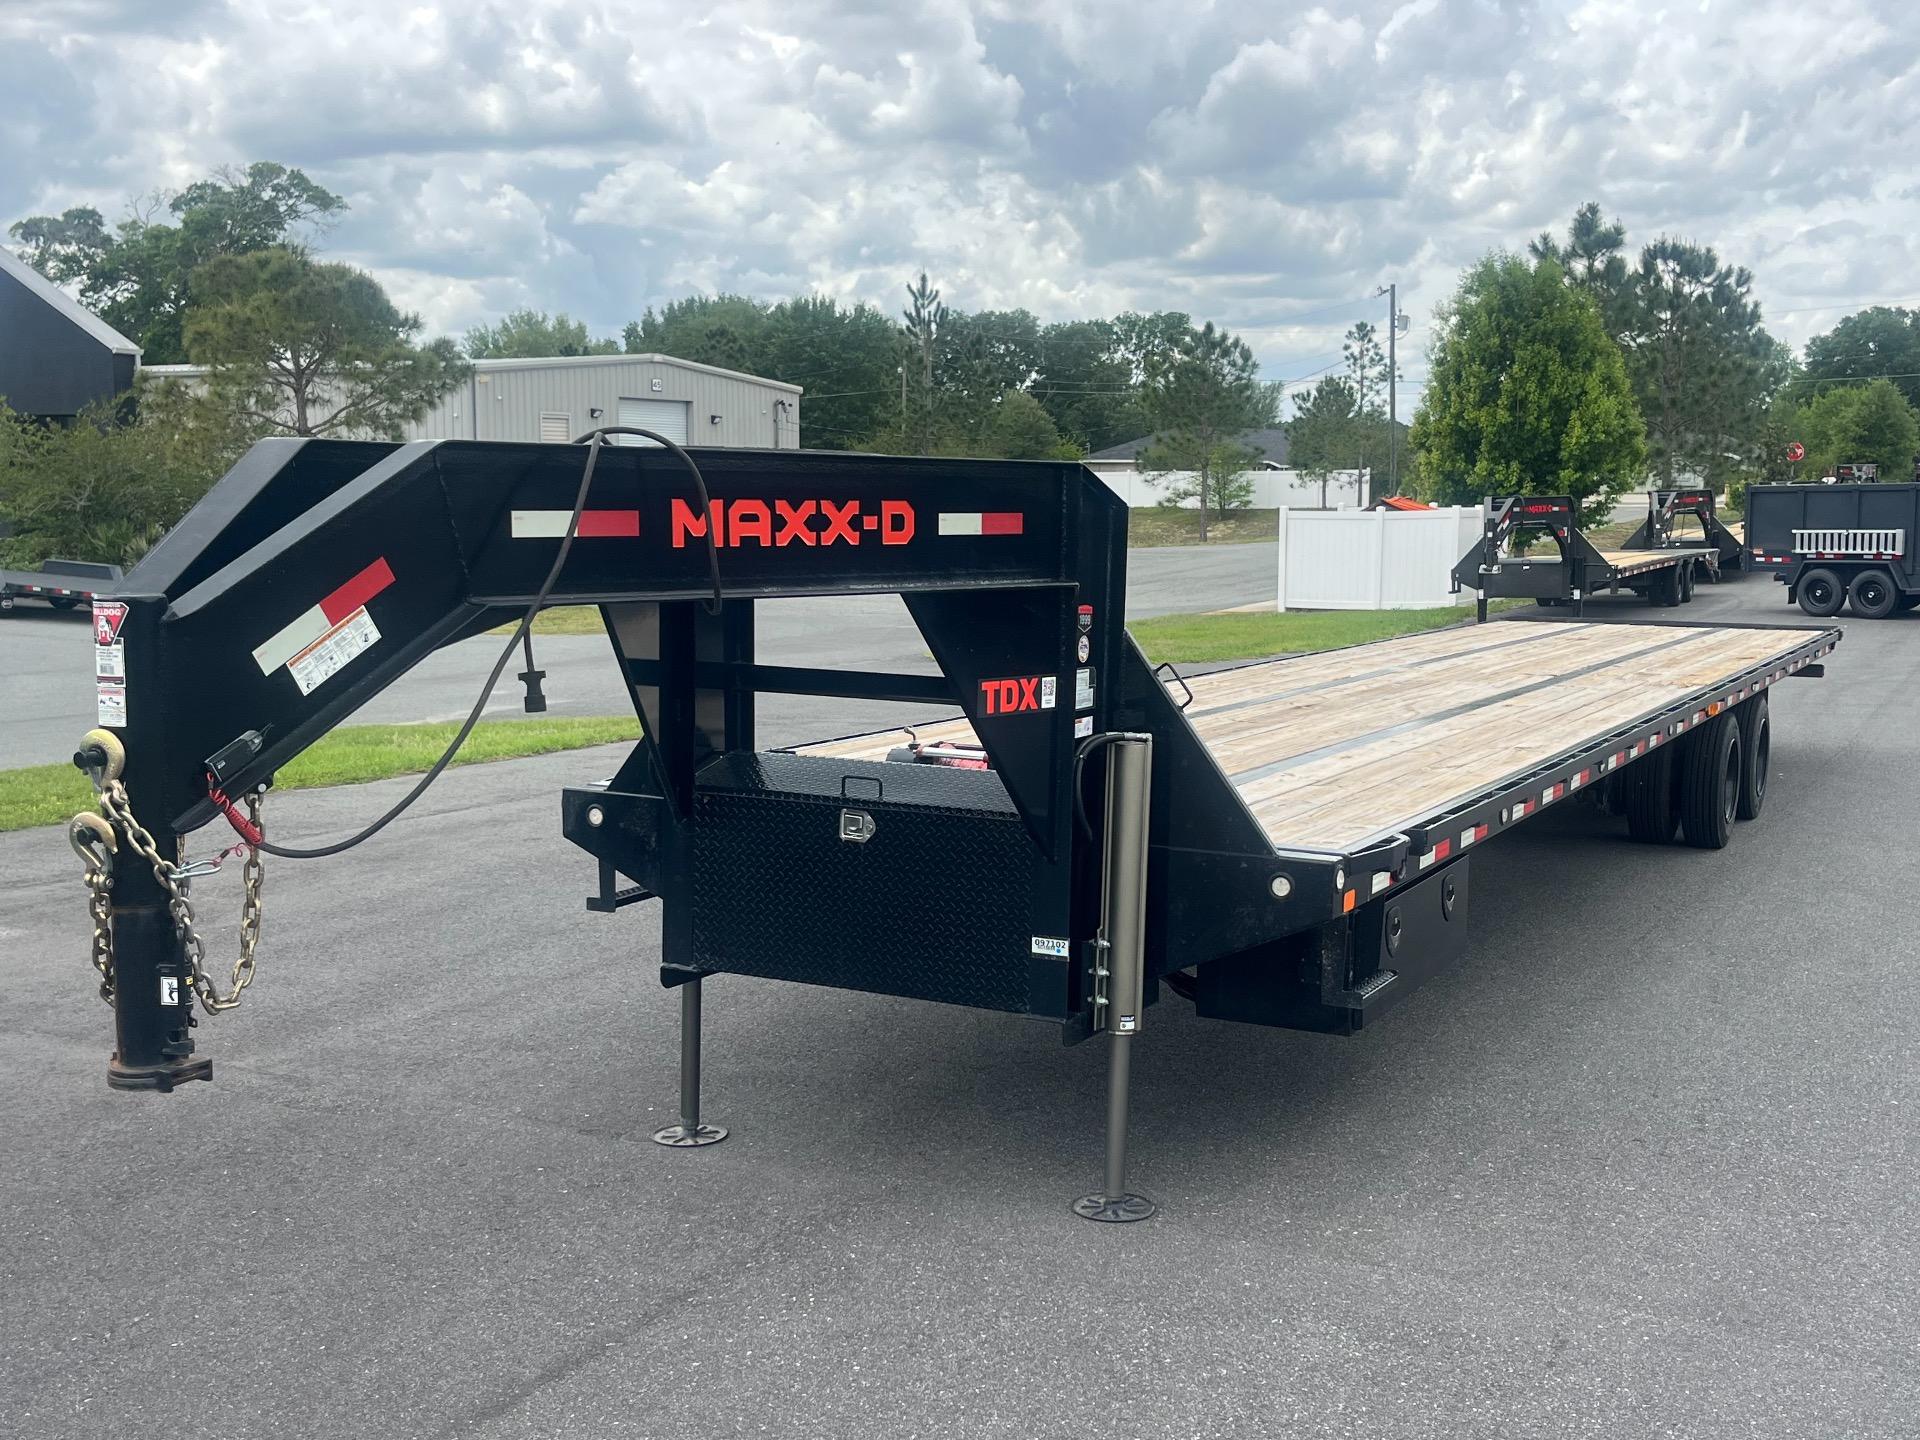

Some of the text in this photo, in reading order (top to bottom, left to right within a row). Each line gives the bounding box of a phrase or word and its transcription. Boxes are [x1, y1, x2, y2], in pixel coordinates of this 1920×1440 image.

[671, 499, 915, 548] MAXX-D
[981, 677, 1039, 715] TDX
[1034, 939, 1066, 948] 097102
